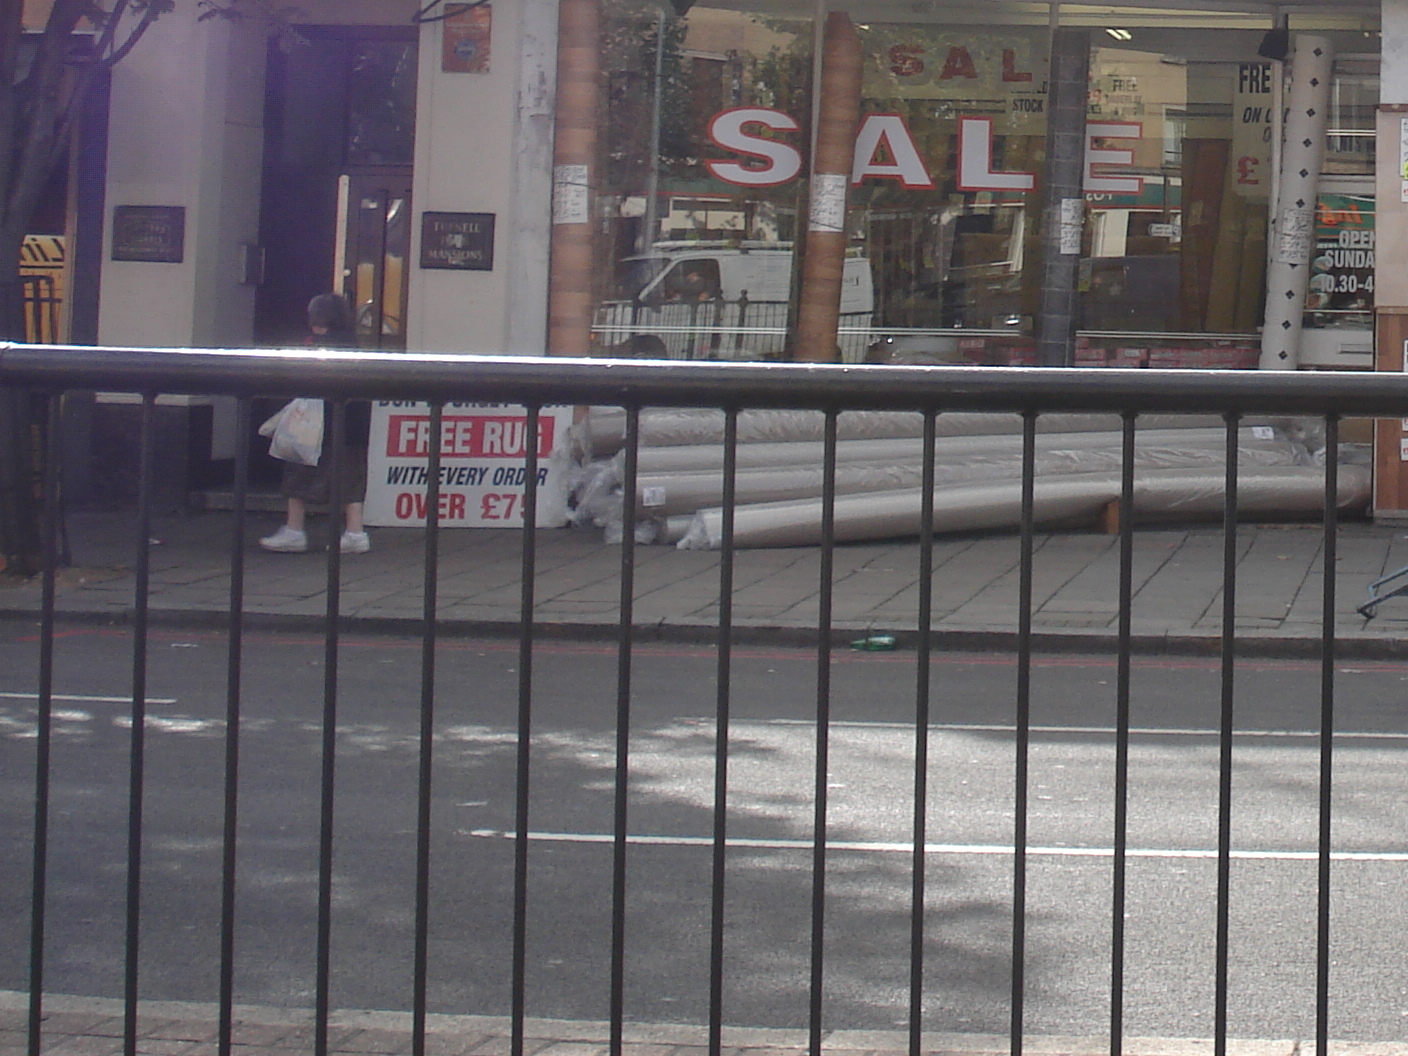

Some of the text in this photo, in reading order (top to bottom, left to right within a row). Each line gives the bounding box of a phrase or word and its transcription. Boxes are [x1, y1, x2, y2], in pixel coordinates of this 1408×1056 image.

[889, 44, 1033, 82] SAL
[1239, 65, 1275, 93] FRE
[1013, 99, 1043, 112] STOCK
[704, 106, 1145, 195] SALE
[1325, 250, 1376, 268] SUNDA
[398, 420, 473, 454] FREE
[386, 466, 549, 486] WITH EVERY ORDR
[395, 492, 466, 520] OVER
